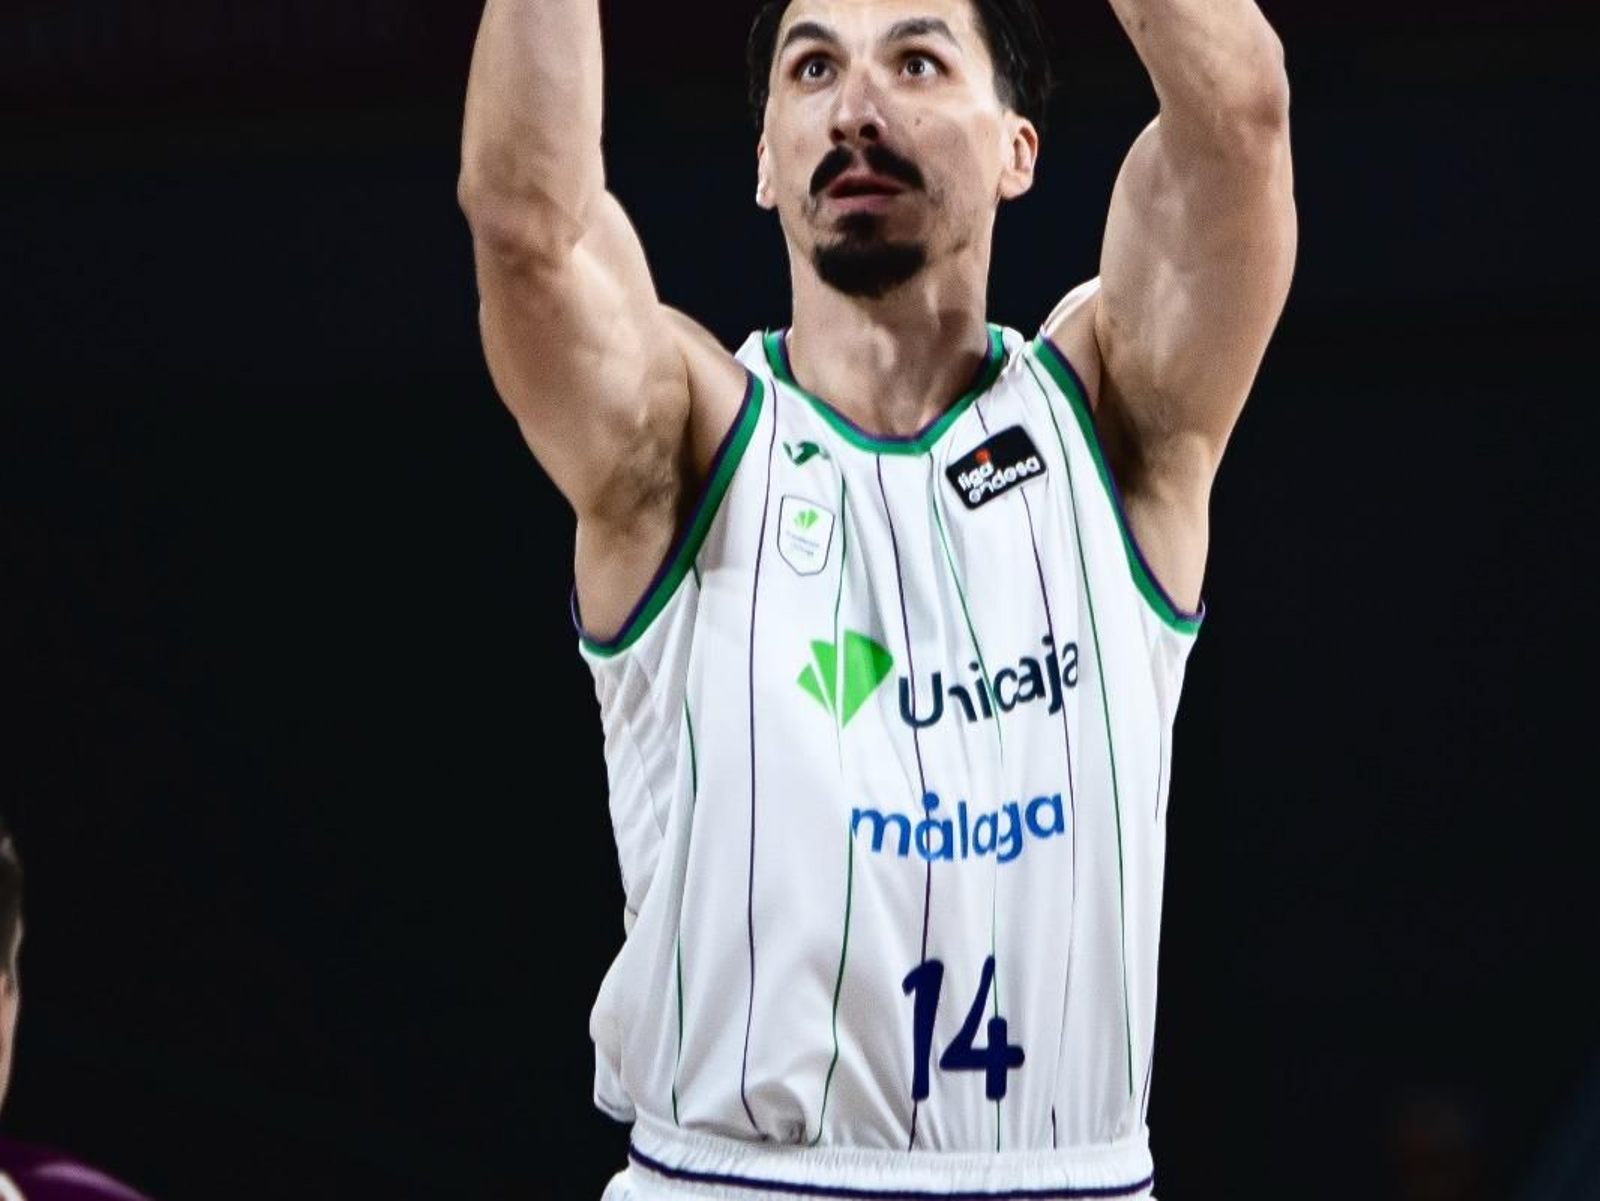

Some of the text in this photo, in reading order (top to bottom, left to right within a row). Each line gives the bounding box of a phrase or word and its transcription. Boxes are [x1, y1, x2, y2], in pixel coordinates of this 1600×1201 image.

[958, 461, 995, 491] liga
[969, 456, 1041, 504] endesa
[898, 635, 1079, 729] Unicaja
[902, 954, 1026, 1101] 14
